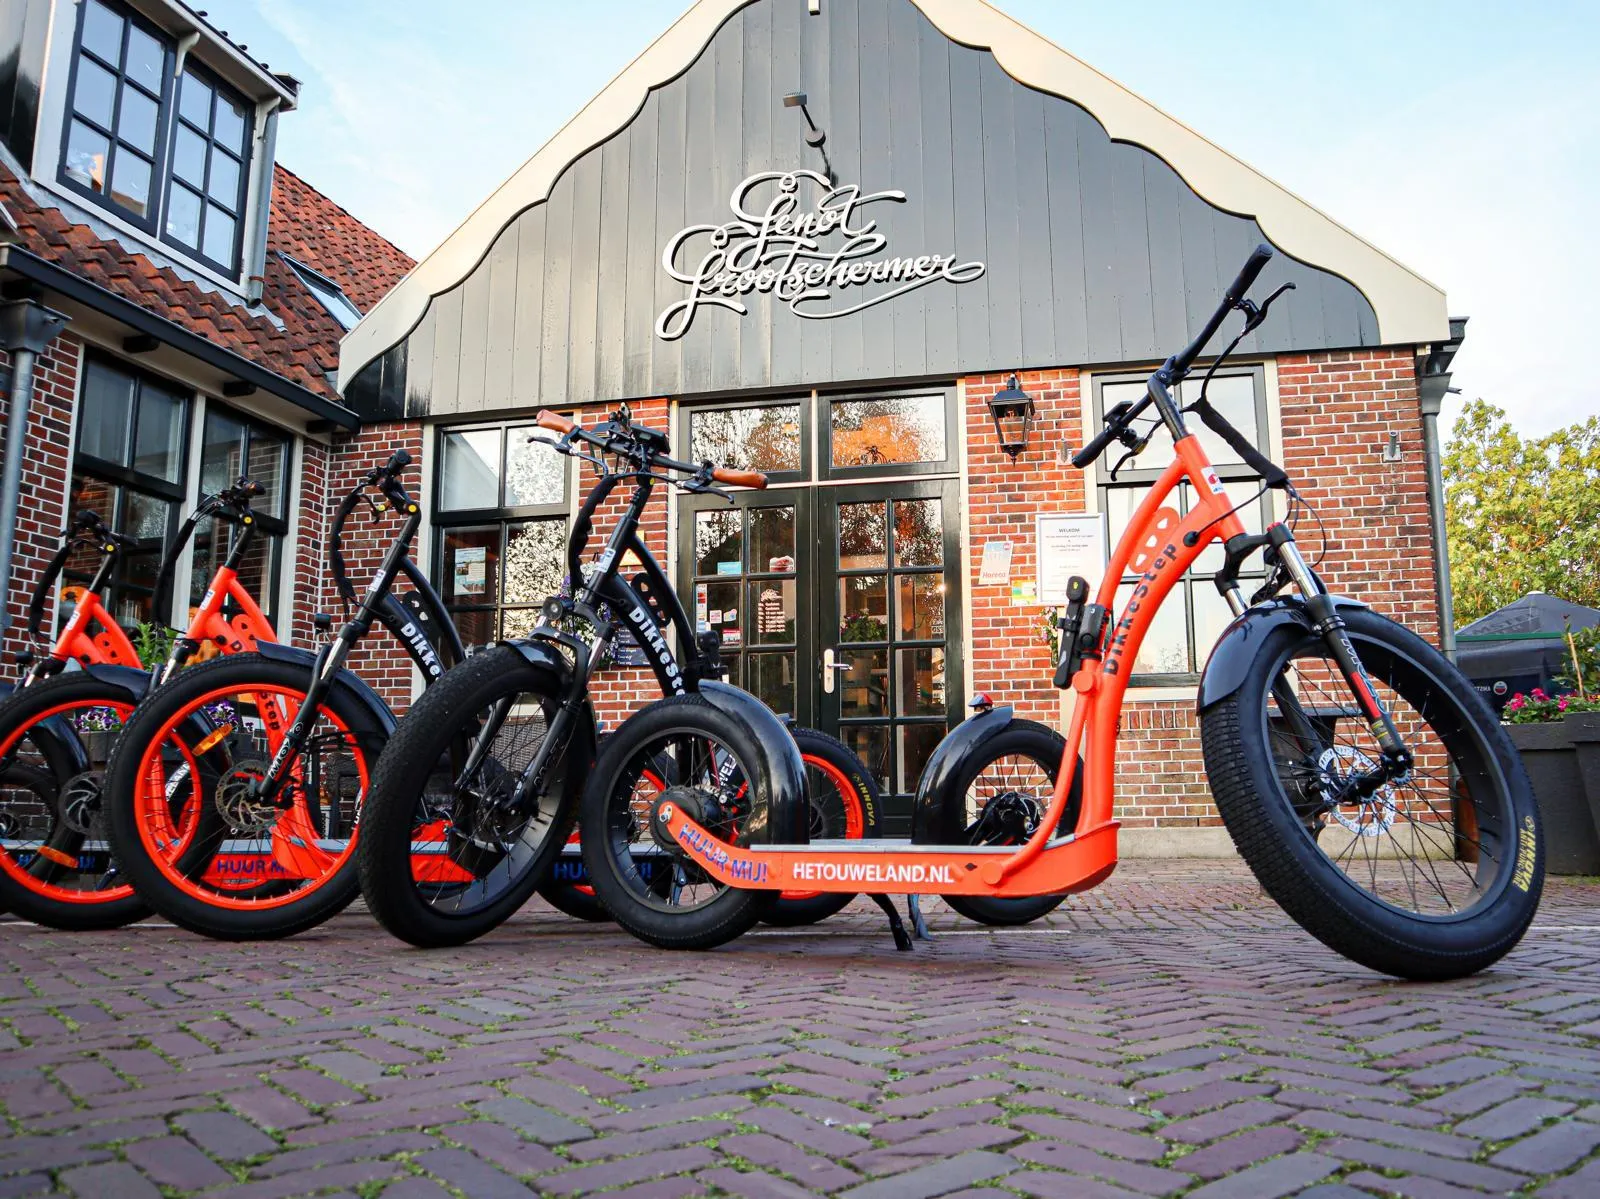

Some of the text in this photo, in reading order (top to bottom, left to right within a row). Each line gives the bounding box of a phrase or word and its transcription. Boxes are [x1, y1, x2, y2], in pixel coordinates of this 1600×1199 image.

[858, 782, 875, 827] INNOVA
[217, 859, 266, 874] HUUR
[678, 823, 769, 883] HUUR MIJ!
[792, 862, 955, 884] HETOUWELAND.NL
[1518, 830, 1536, 893] INNOVA
